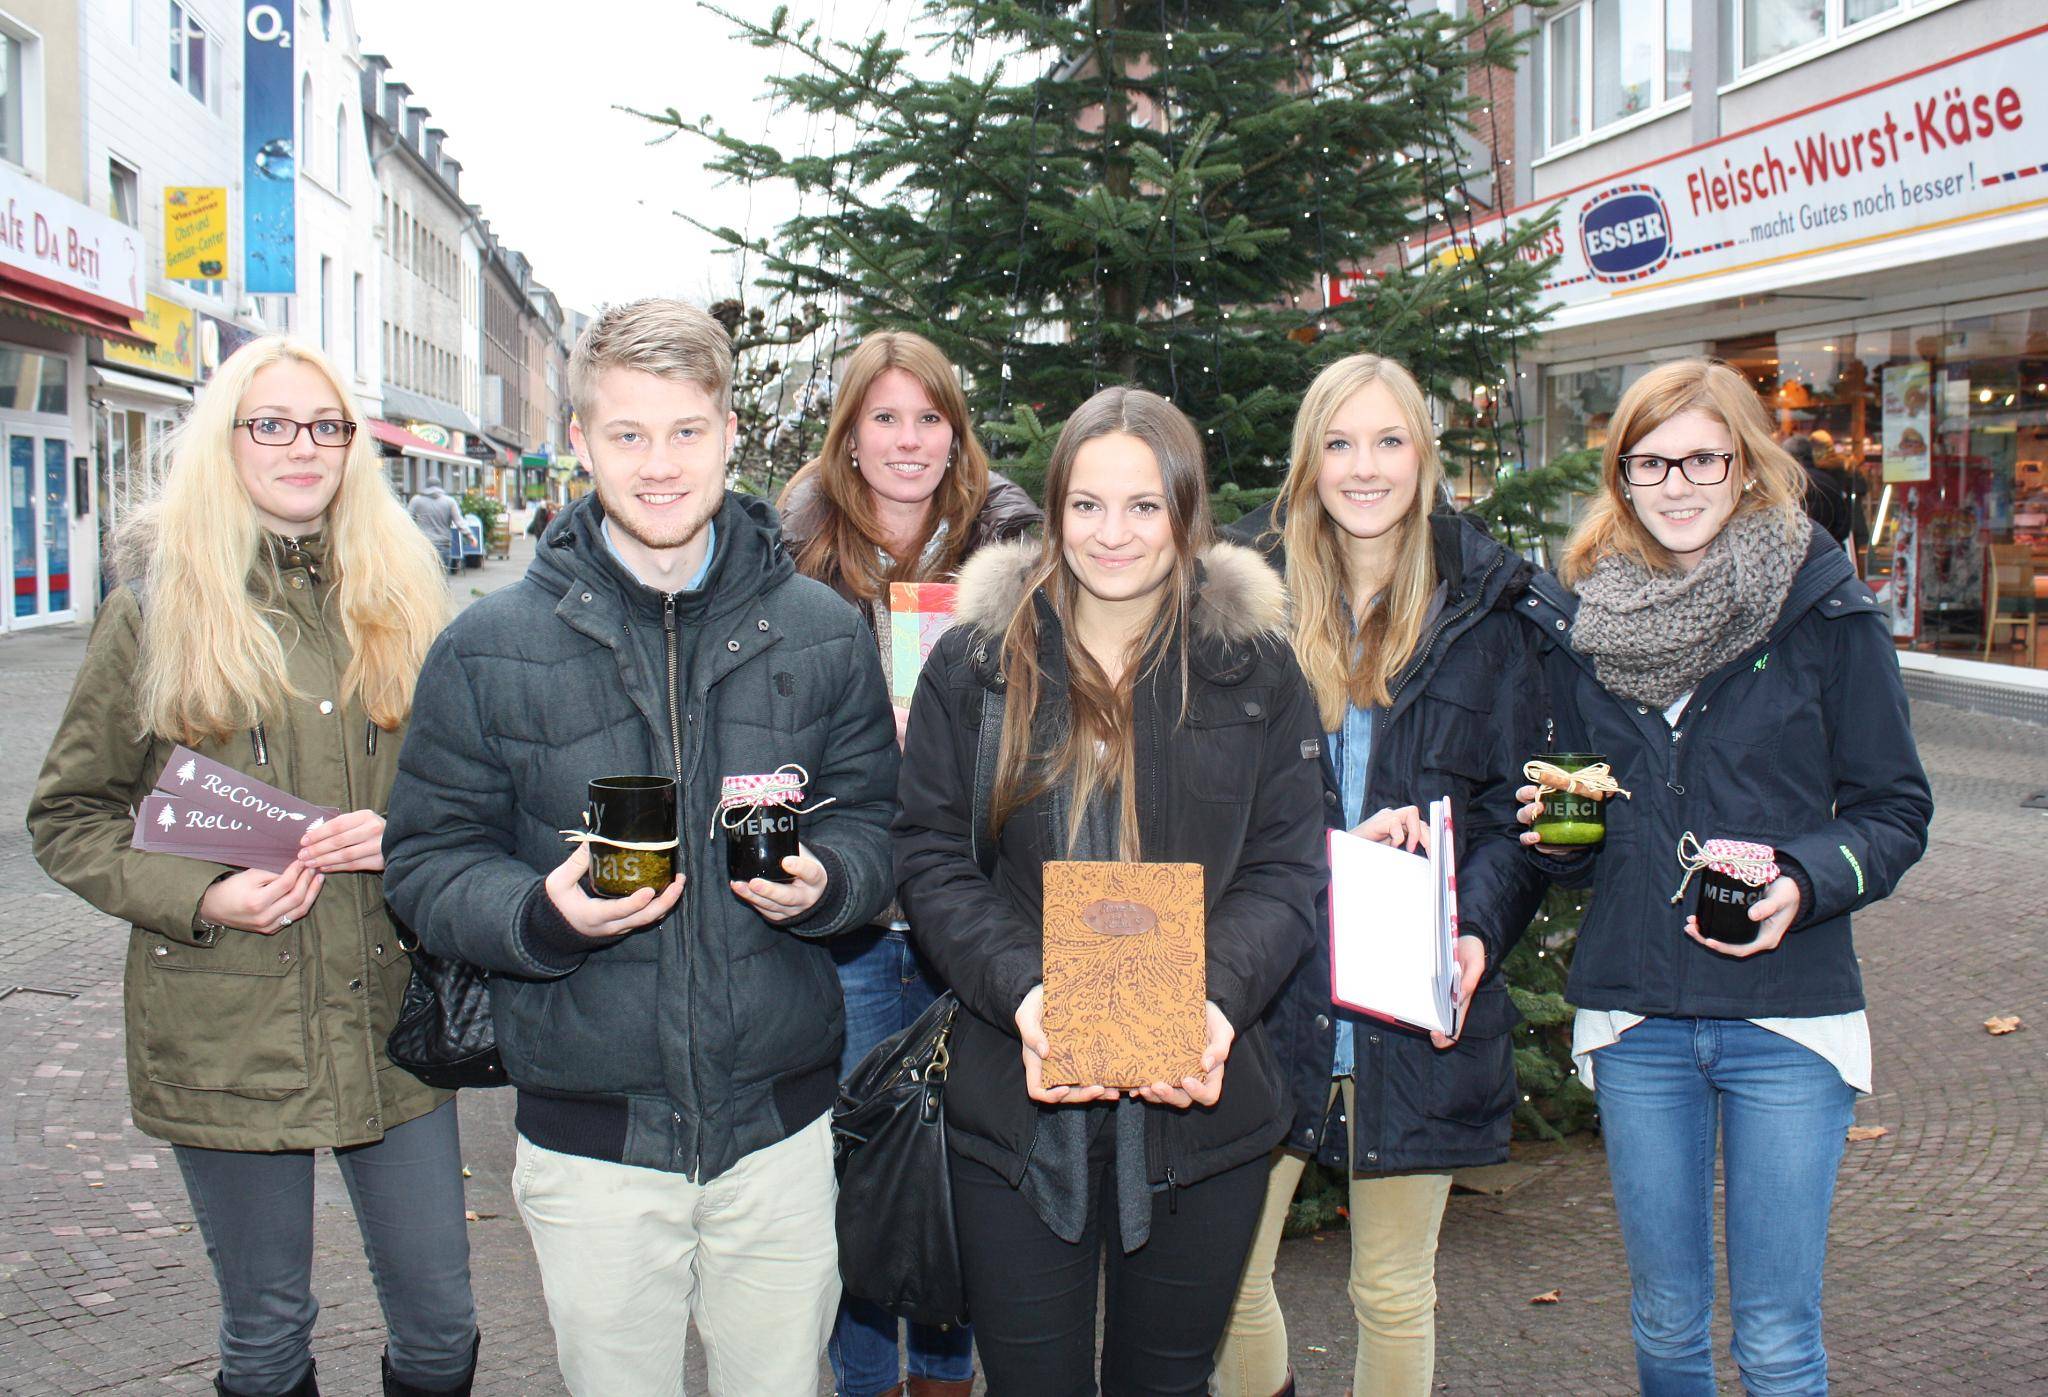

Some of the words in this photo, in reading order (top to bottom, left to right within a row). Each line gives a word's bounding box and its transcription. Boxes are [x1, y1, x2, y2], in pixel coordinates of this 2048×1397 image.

[1687, 86, 2024, 217] Fleisch-Wurst-Käse
[1800, 203, 1848, 230] Gutes
[1853, 184, 1896, 218] noch
[1586, 213, 1665, 256] ESSER
[201, 773, 294, 822] ReCover
[1543, 801, 1597, 816] MERCI
[731, 815, 794, 836] MERCI
